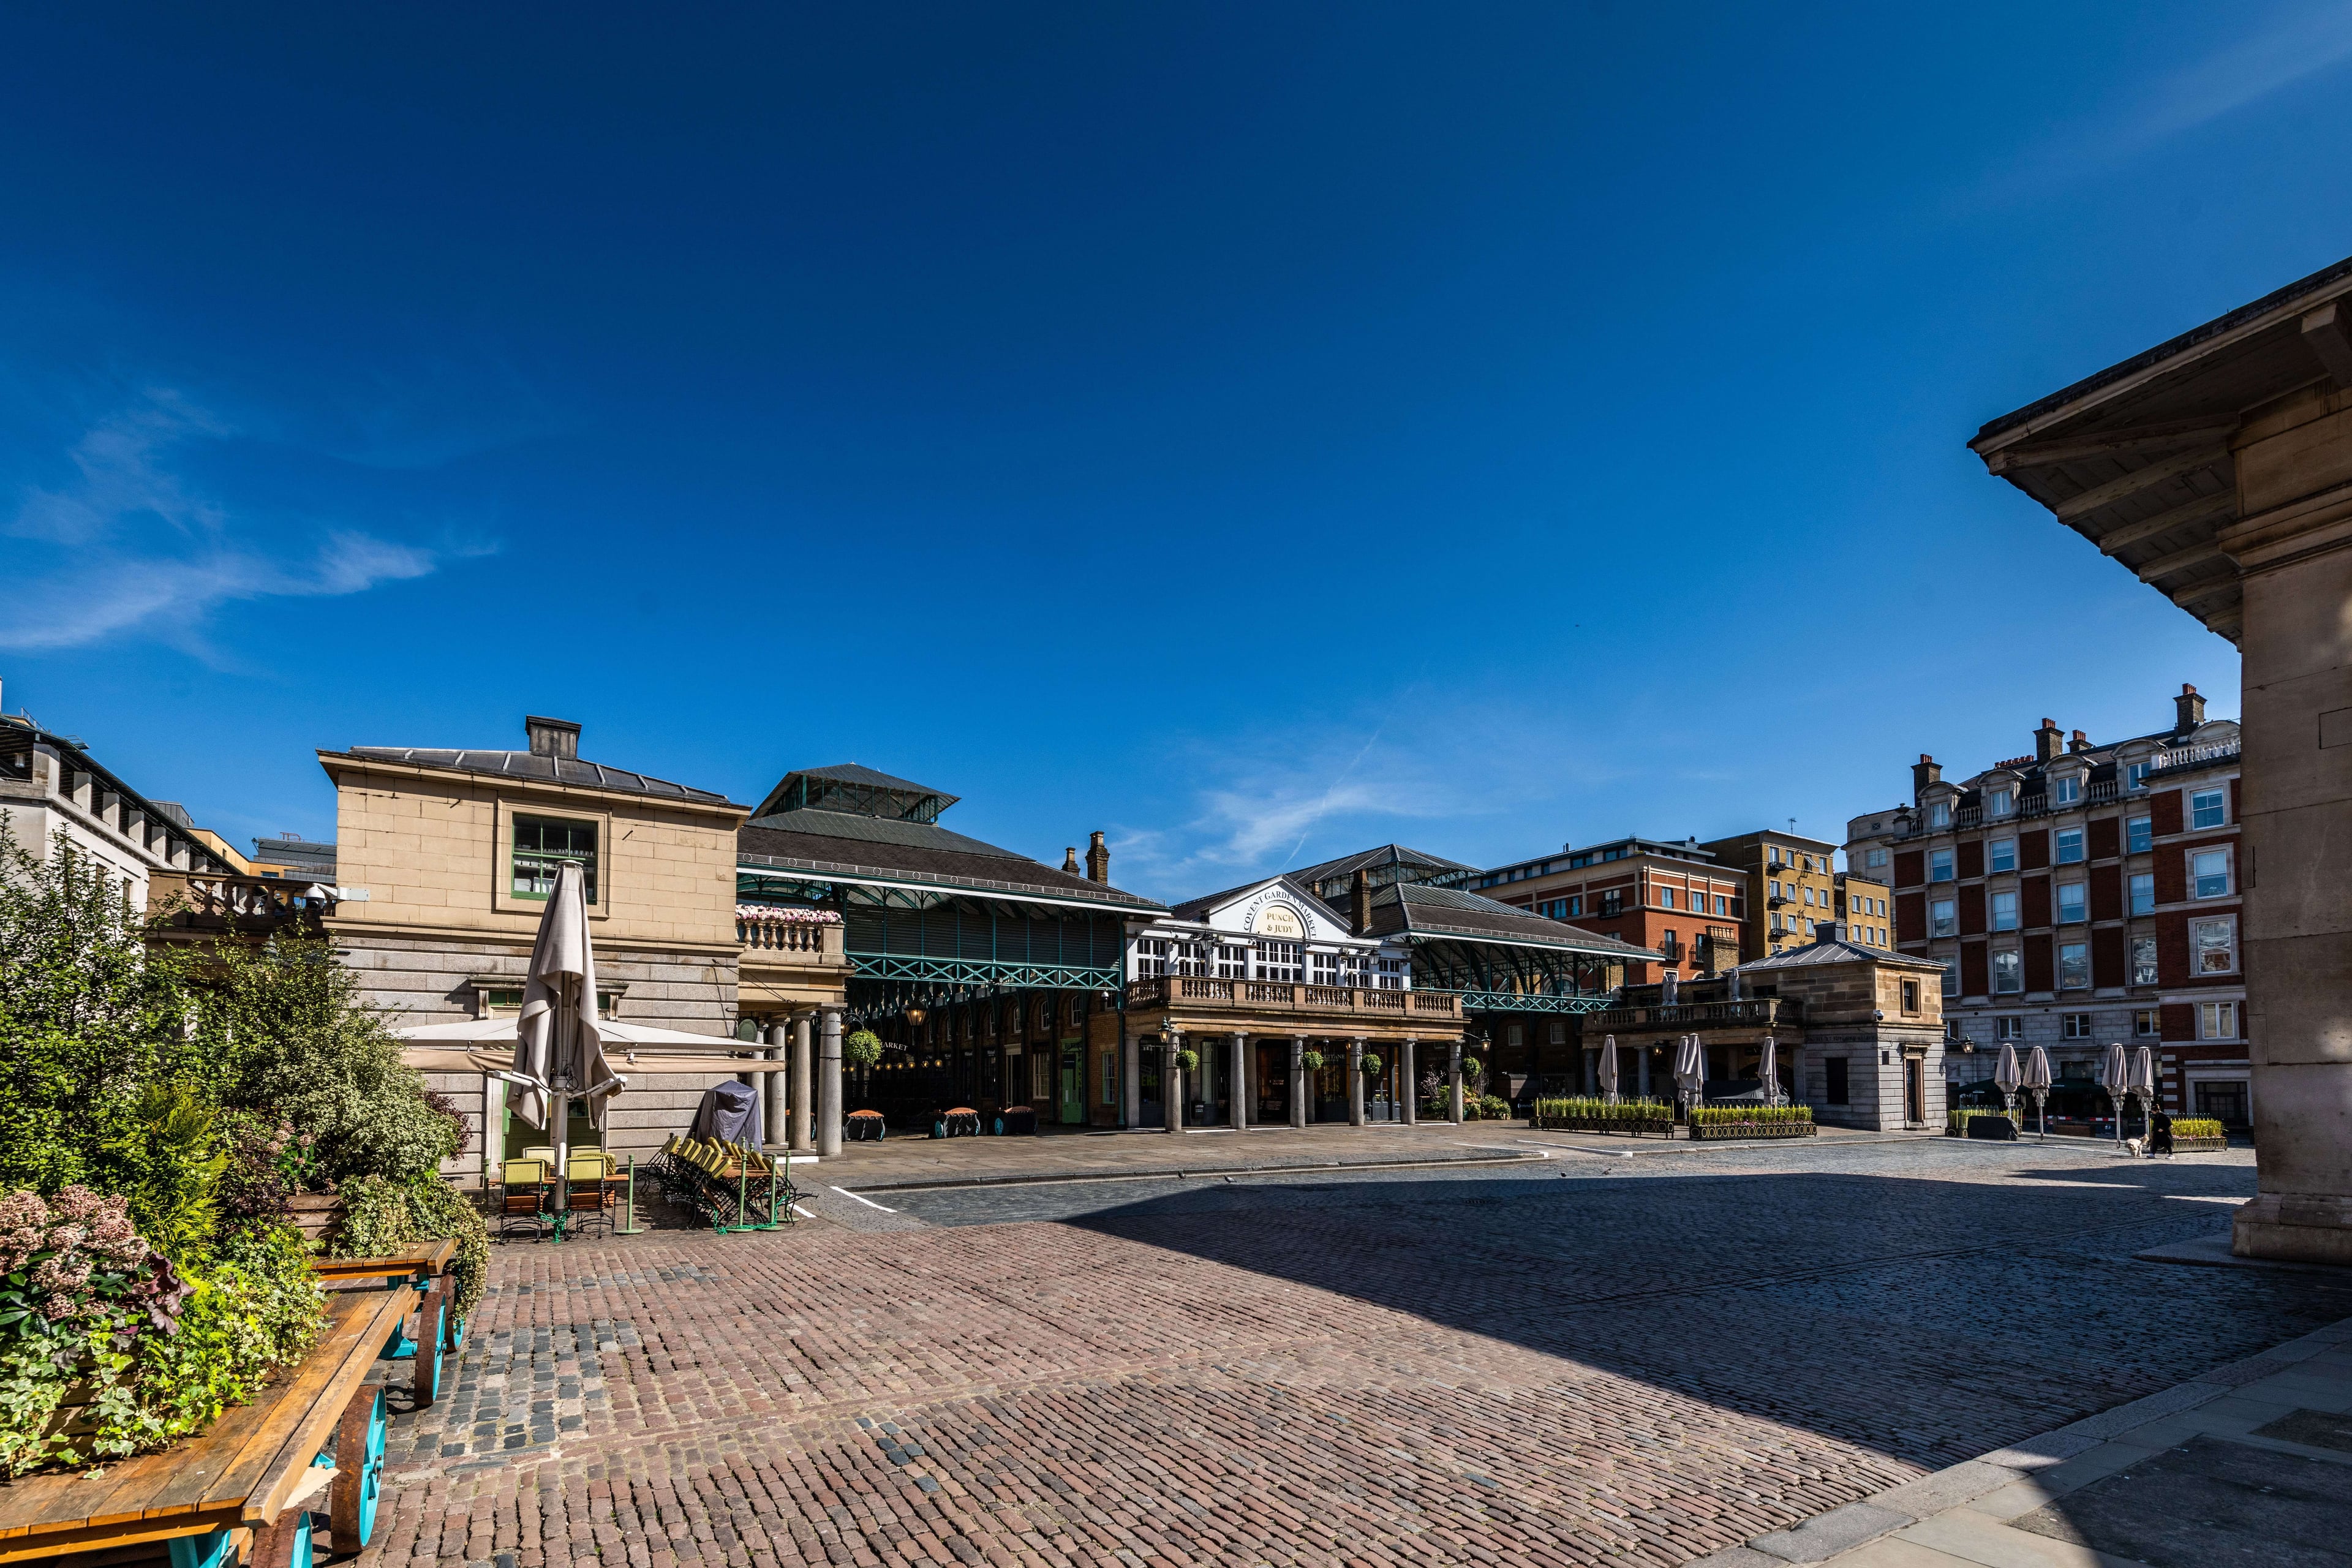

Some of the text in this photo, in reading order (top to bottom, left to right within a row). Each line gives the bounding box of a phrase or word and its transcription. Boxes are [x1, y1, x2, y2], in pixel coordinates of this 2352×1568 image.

[1243, 891, 1317, 938] COVENT GARDEN MARKET
[1267, 913, 1294, 922] PUNCH
